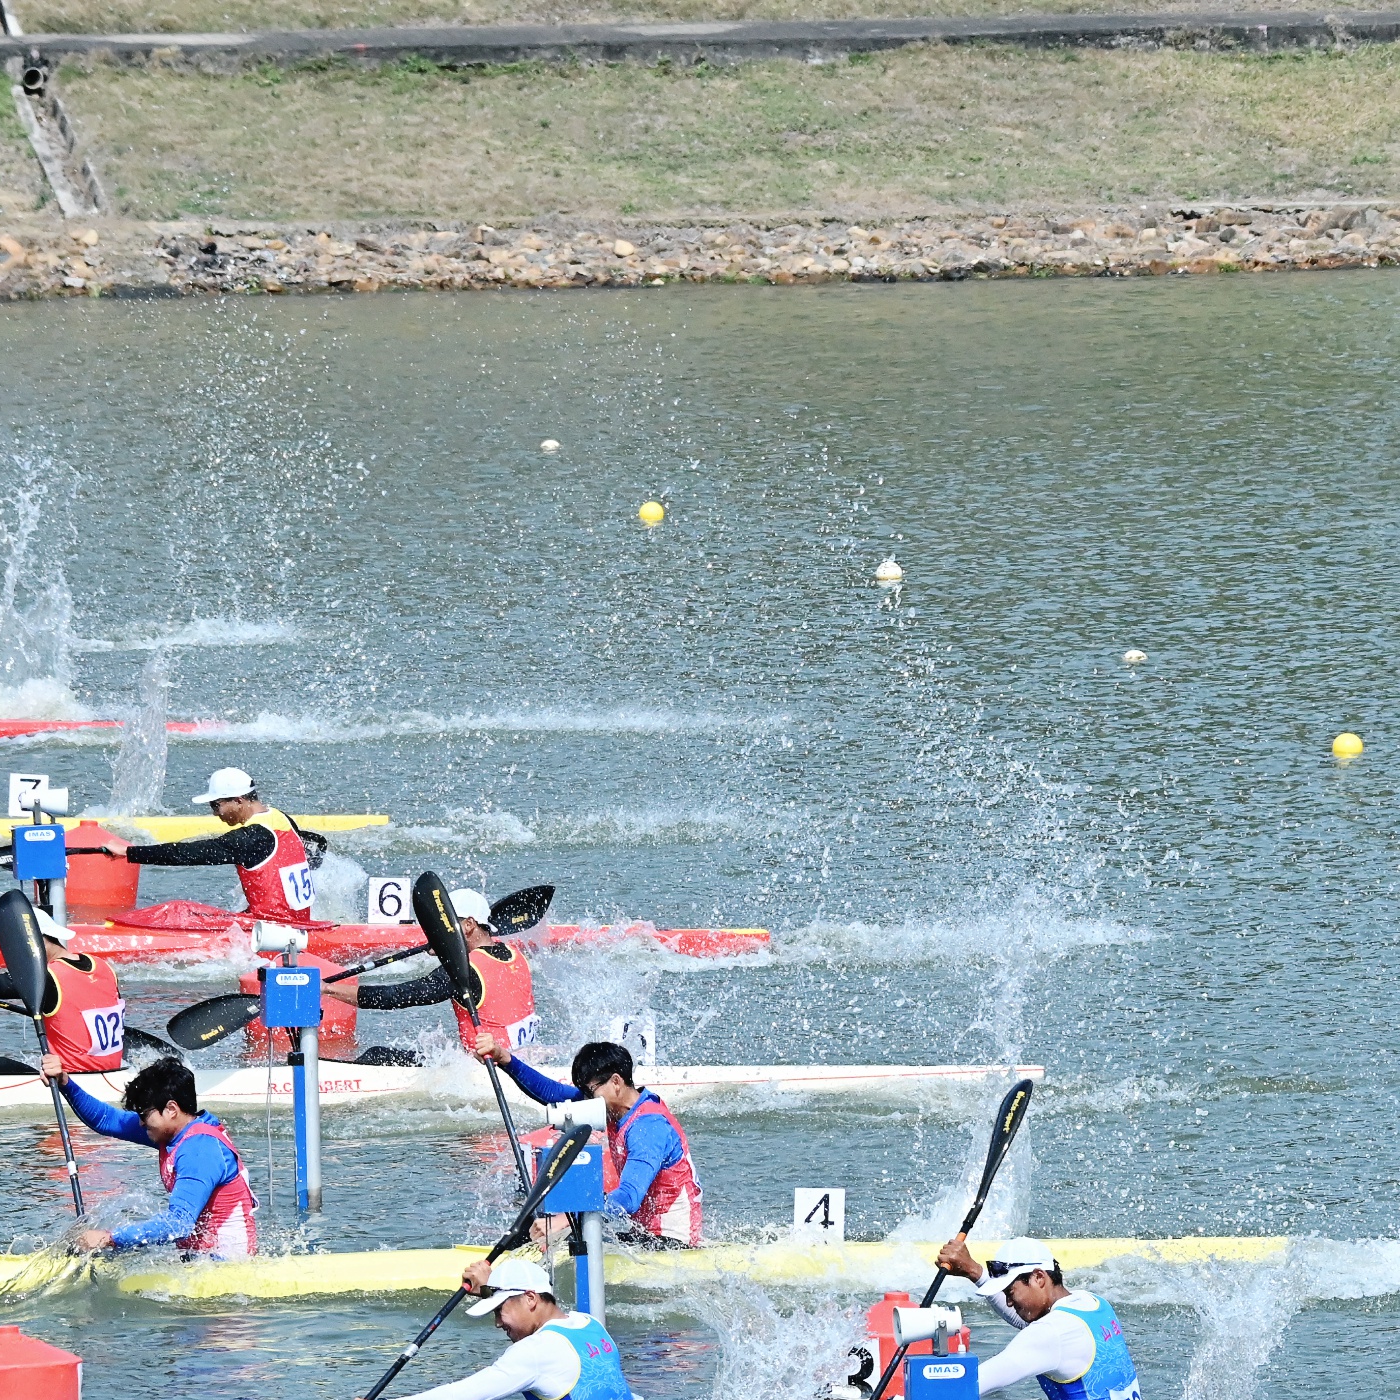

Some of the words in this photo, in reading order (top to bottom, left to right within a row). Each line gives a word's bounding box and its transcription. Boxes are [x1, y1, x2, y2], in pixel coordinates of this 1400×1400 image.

[378, 881, 403, 917] 6
[804, 1193, 835, 1230] 4
[847, 1346, 875, 1399] 3
[928, 1365, 960, 1374] IMAS
